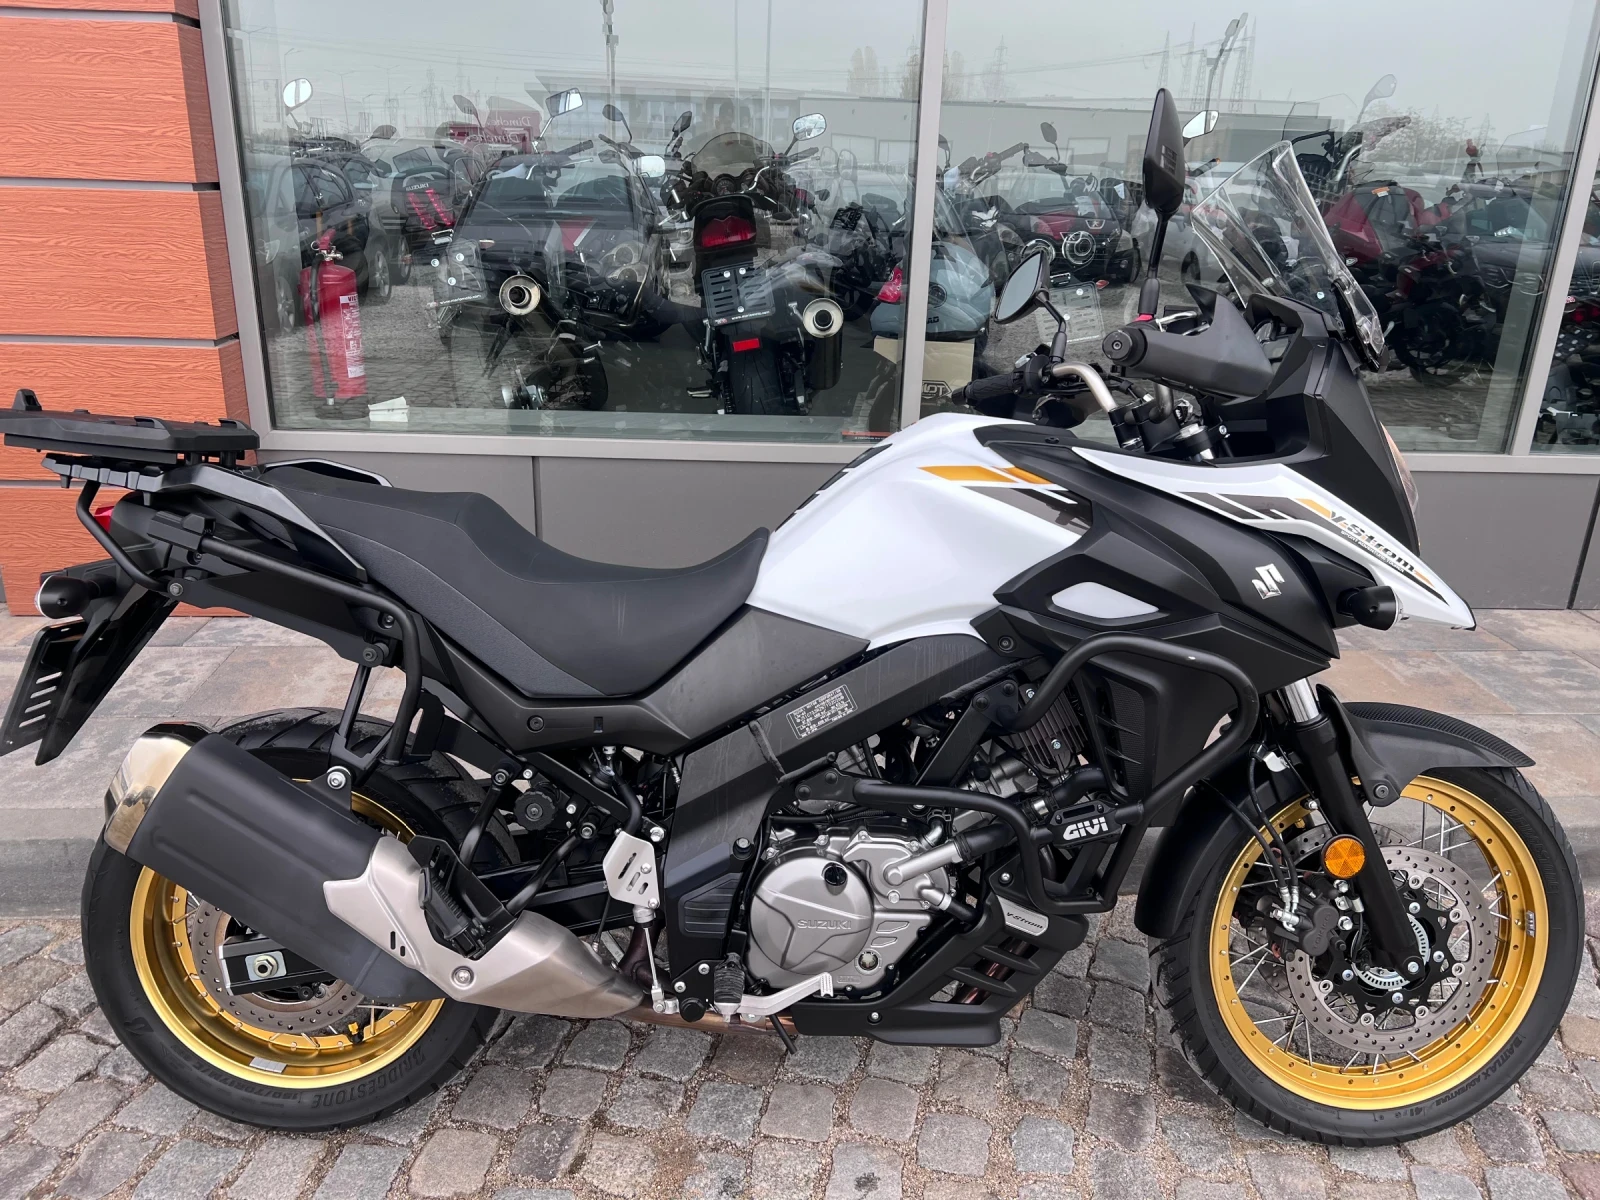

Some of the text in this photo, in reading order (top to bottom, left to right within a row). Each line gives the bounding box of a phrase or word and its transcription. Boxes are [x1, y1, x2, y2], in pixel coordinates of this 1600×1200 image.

[1340, 529, 1359, 545] SPORT
[1062, 816, 1109, 841] GIVI
[797, 919, 852, 930] SUZUKI
[311, 1048, 427, 1110] BRIDGESTONE
